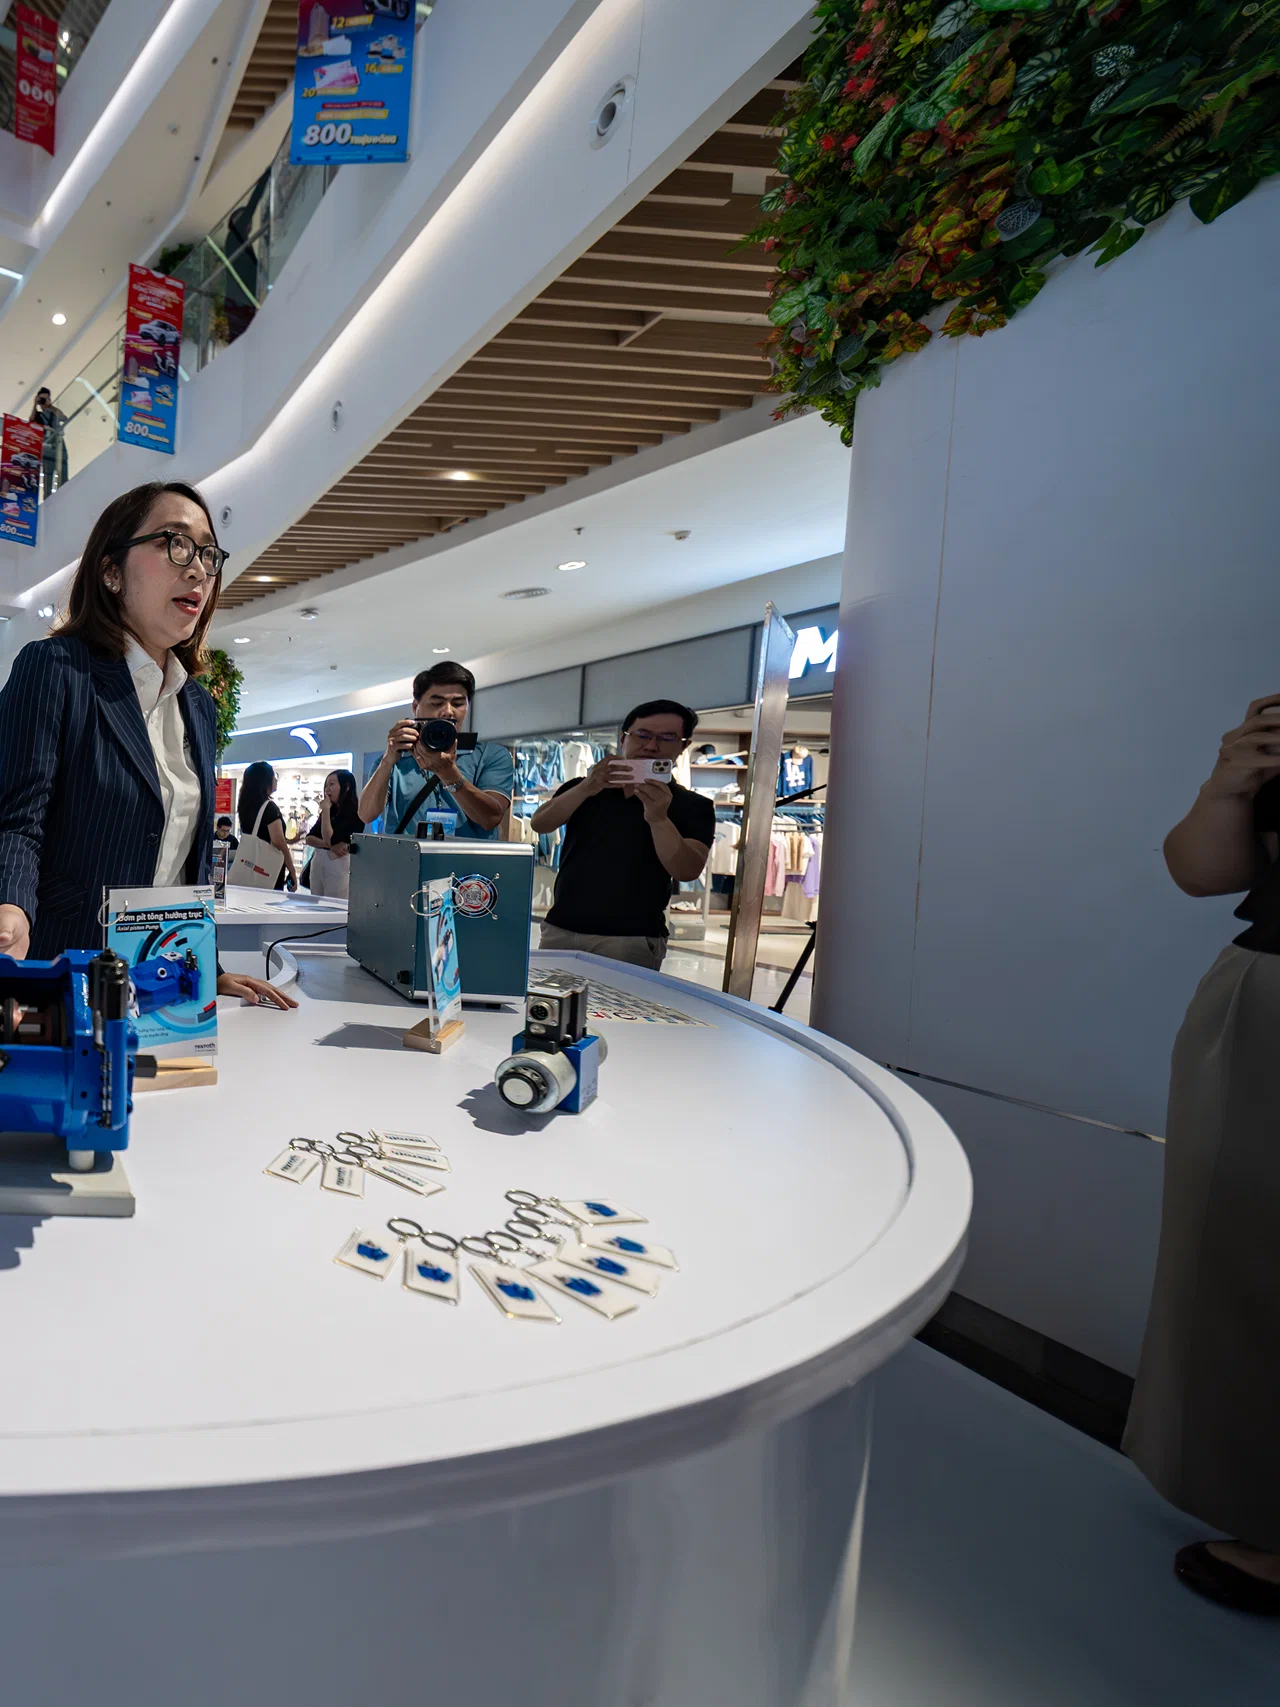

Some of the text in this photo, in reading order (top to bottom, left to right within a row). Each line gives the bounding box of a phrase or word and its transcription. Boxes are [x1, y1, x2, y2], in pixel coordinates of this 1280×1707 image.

[303, 123, 352, 146] 800
[124, 421, 149, 437] 800
[0, 523, 17, 535] 800
[147, 912, 164, 922] tông
